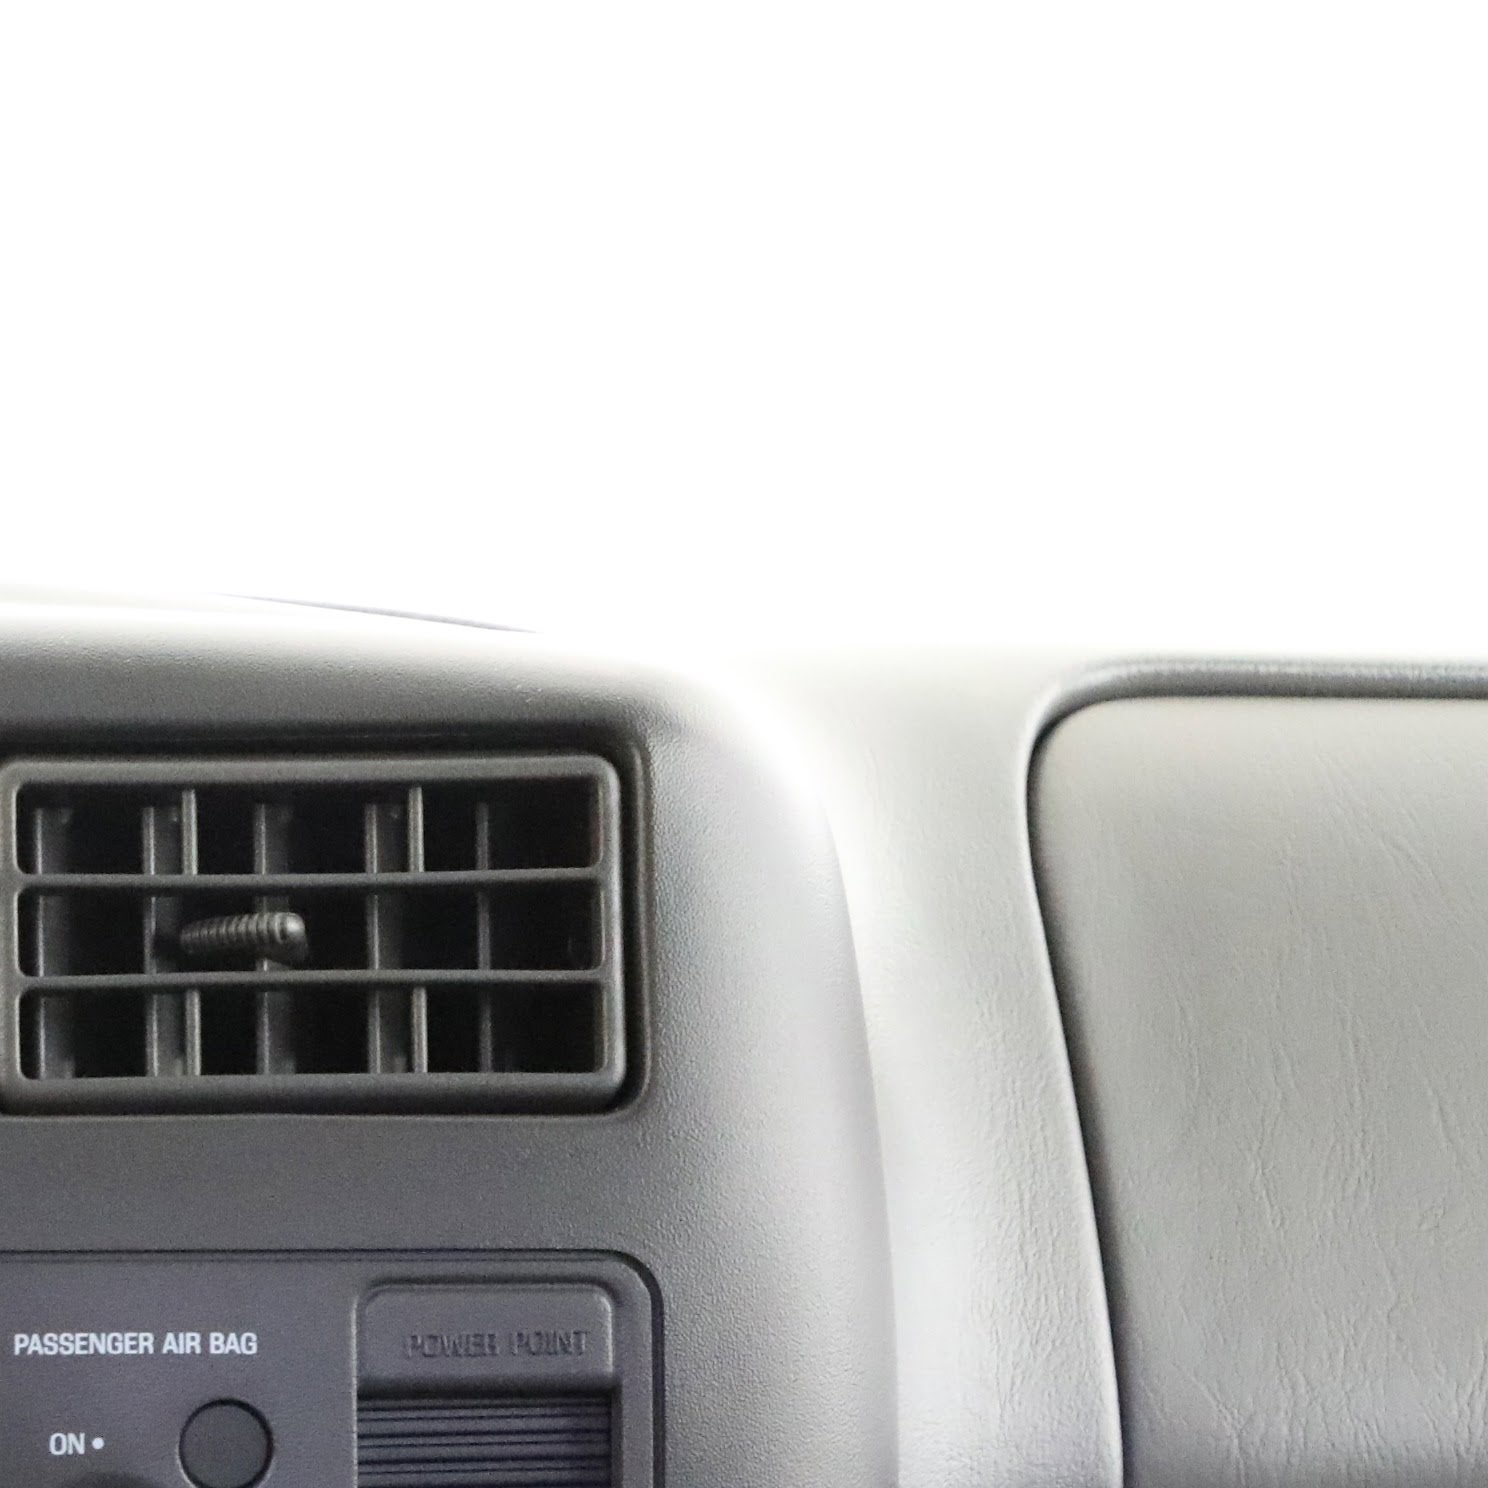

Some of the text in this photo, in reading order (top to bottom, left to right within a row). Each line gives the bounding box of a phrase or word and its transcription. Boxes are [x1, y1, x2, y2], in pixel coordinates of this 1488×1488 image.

[13, 1333, 258, 1355] PASSENGER AIR BAG
[49, 1433, 85, 1456] ON
